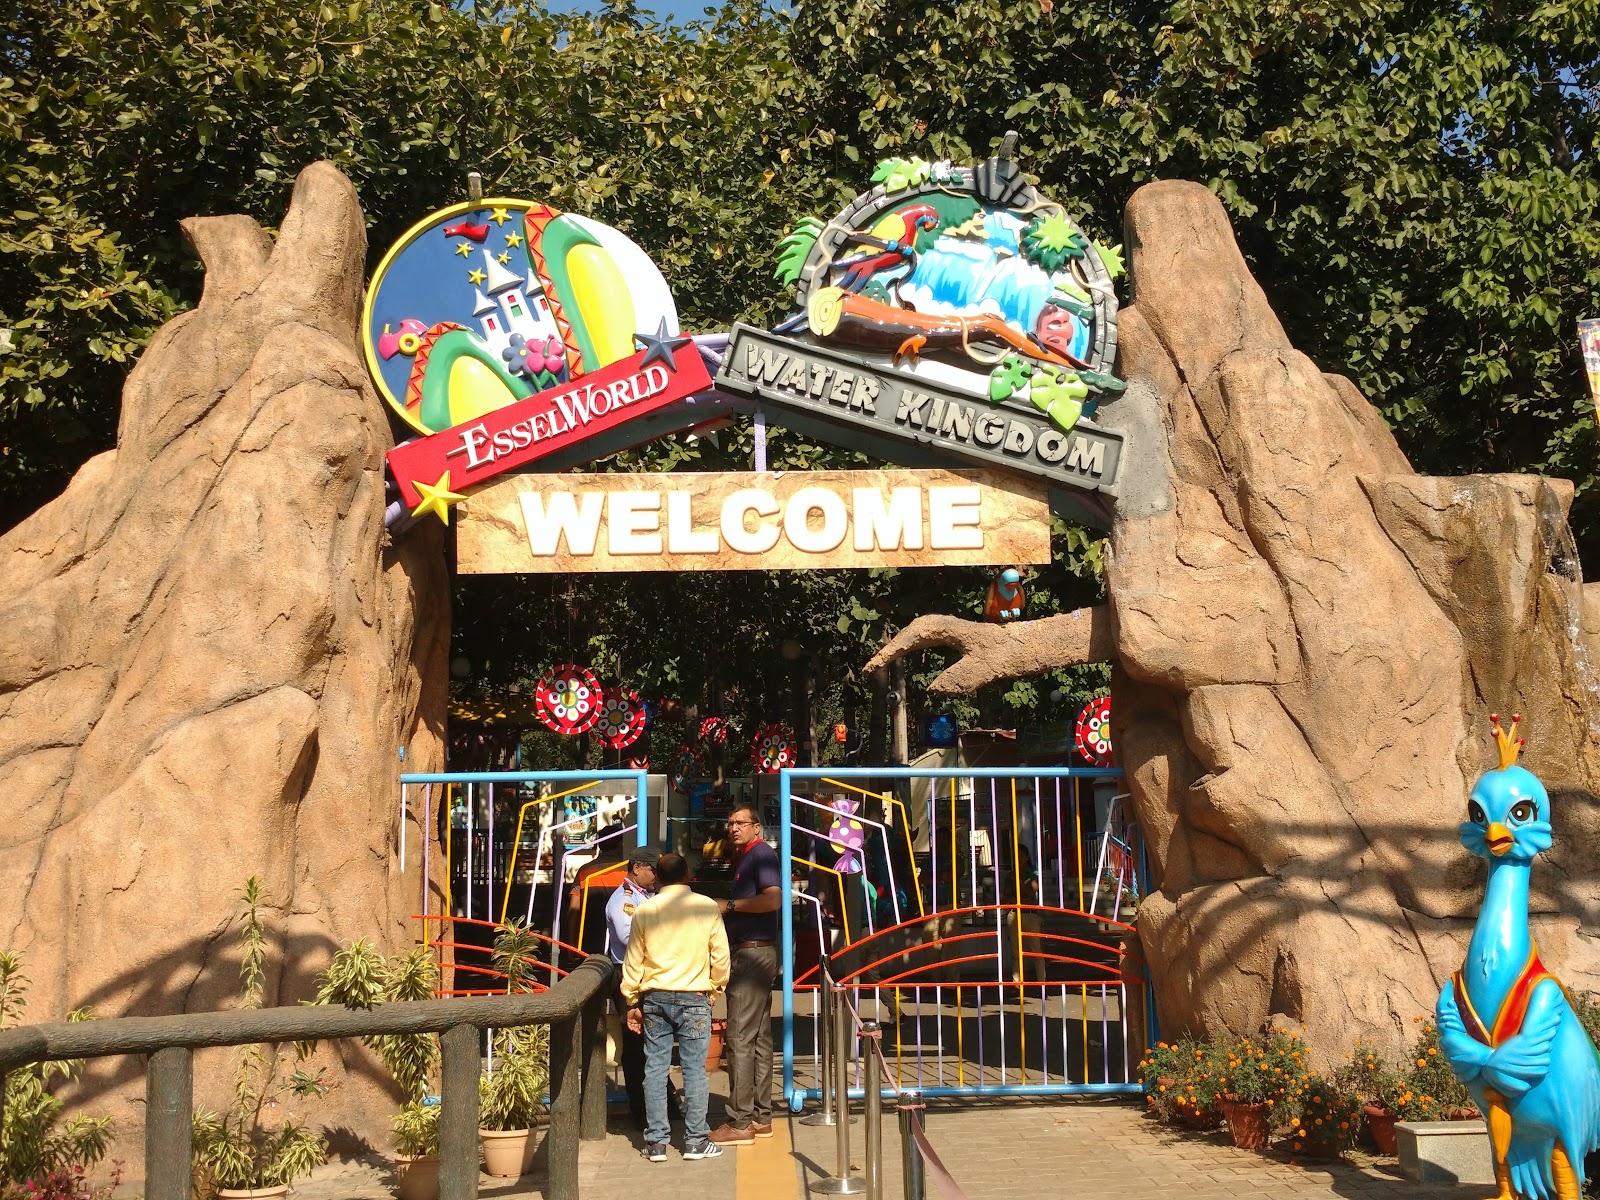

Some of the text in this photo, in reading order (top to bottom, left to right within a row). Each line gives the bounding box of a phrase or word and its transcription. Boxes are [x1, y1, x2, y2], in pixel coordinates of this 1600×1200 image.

[746, 342, 1106, 477] WATER KINGDOM
[518, 486, 984, 557] WELCOME
